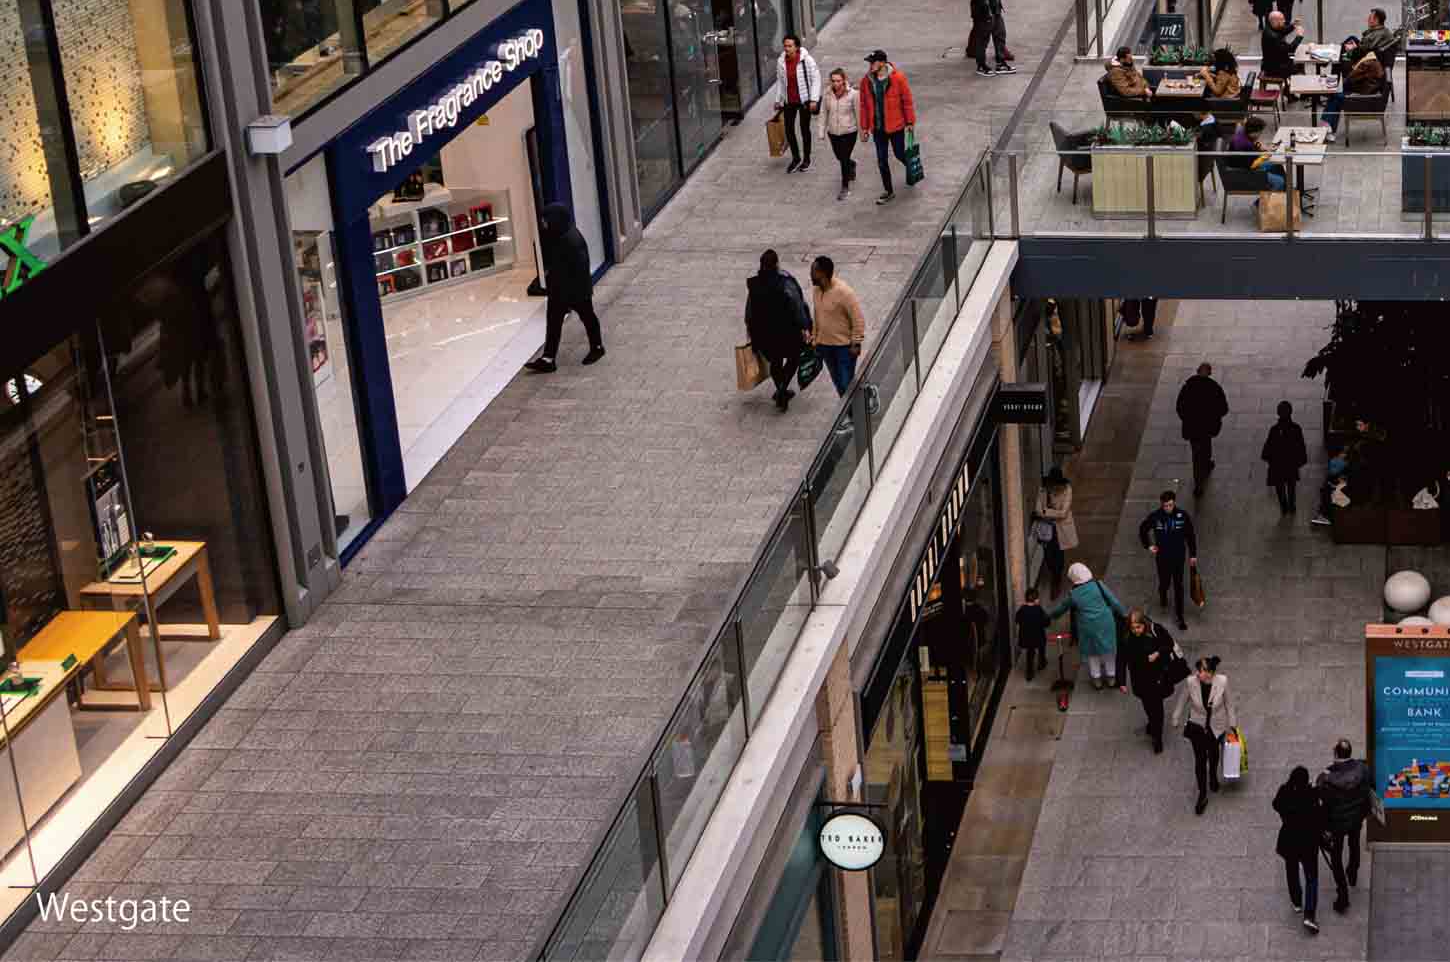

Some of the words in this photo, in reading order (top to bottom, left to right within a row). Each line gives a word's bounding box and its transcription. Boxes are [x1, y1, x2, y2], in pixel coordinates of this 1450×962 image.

[371, 130, 413, 173] The
[411, 59, 503, 145] Fragrance
[502, 27, 545, 73] Shop
[1407, 707, 1442, 717] BANK
[821, 834, 841, 843] TED
[848, 835, 882, 843] BAKER
